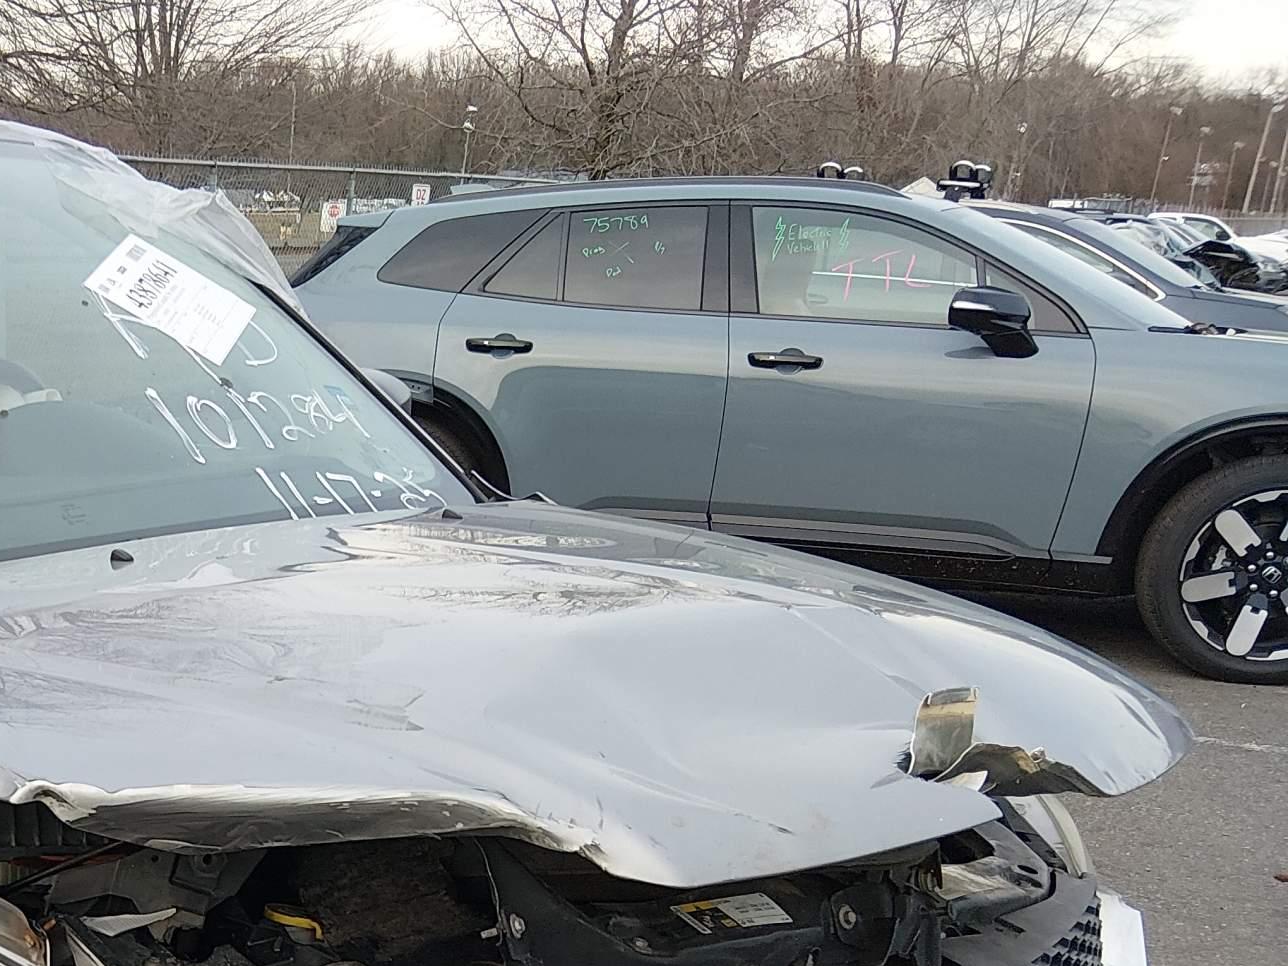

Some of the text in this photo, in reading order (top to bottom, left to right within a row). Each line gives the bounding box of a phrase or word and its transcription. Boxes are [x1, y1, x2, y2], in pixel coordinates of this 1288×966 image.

[583, 214, 649, 233] 75789
[126, 259, 178, 310] 43878641
[831, 249, 934, 304] TTL
